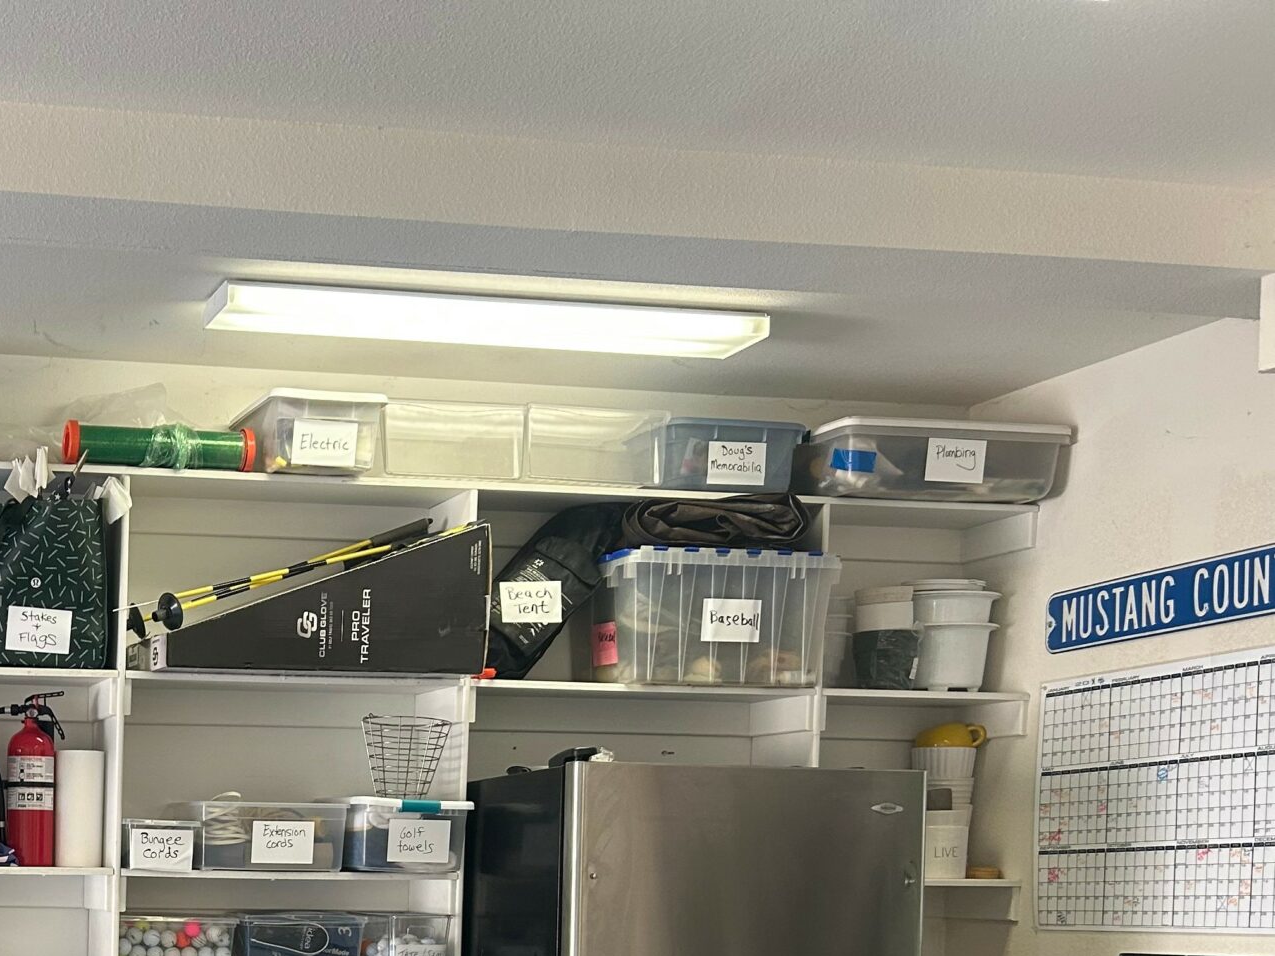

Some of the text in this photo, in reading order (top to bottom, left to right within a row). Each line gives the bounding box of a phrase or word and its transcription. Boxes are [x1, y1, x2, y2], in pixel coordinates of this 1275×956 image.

[299, 432, 350, 452] Electric
[721, 444, 753, 461] Doug's
[936, 444, 977, 470] Plumbing
[710, 458, 762, 474] Memorabilia
[505, 586, 553, 600] Beach
[1062, 554, 1275, 642] MUSTANG COUN
[513, 601, 550, 614] Tent
[20, 611, 58, 625] Stakes
[319, 591, 328, 658] CLUB GLOVE
[351, 610, 361, 641] PRO
[360, 588, 372, 664] TRAVELER
[710, 610, 760, 632] Baseball
[18, 633, 58, 649] Flags
[1182, 664, 1204, 672] MARCH
[140, 832, 185, 845] Bungee
[263, 824, 306, 838] Extension
[399, 827, 425, 840] Golf
[933, 845, 959, 859] LIVE
[304, 928, 314, 949] idea
[338, 926, 352, 937] 3
